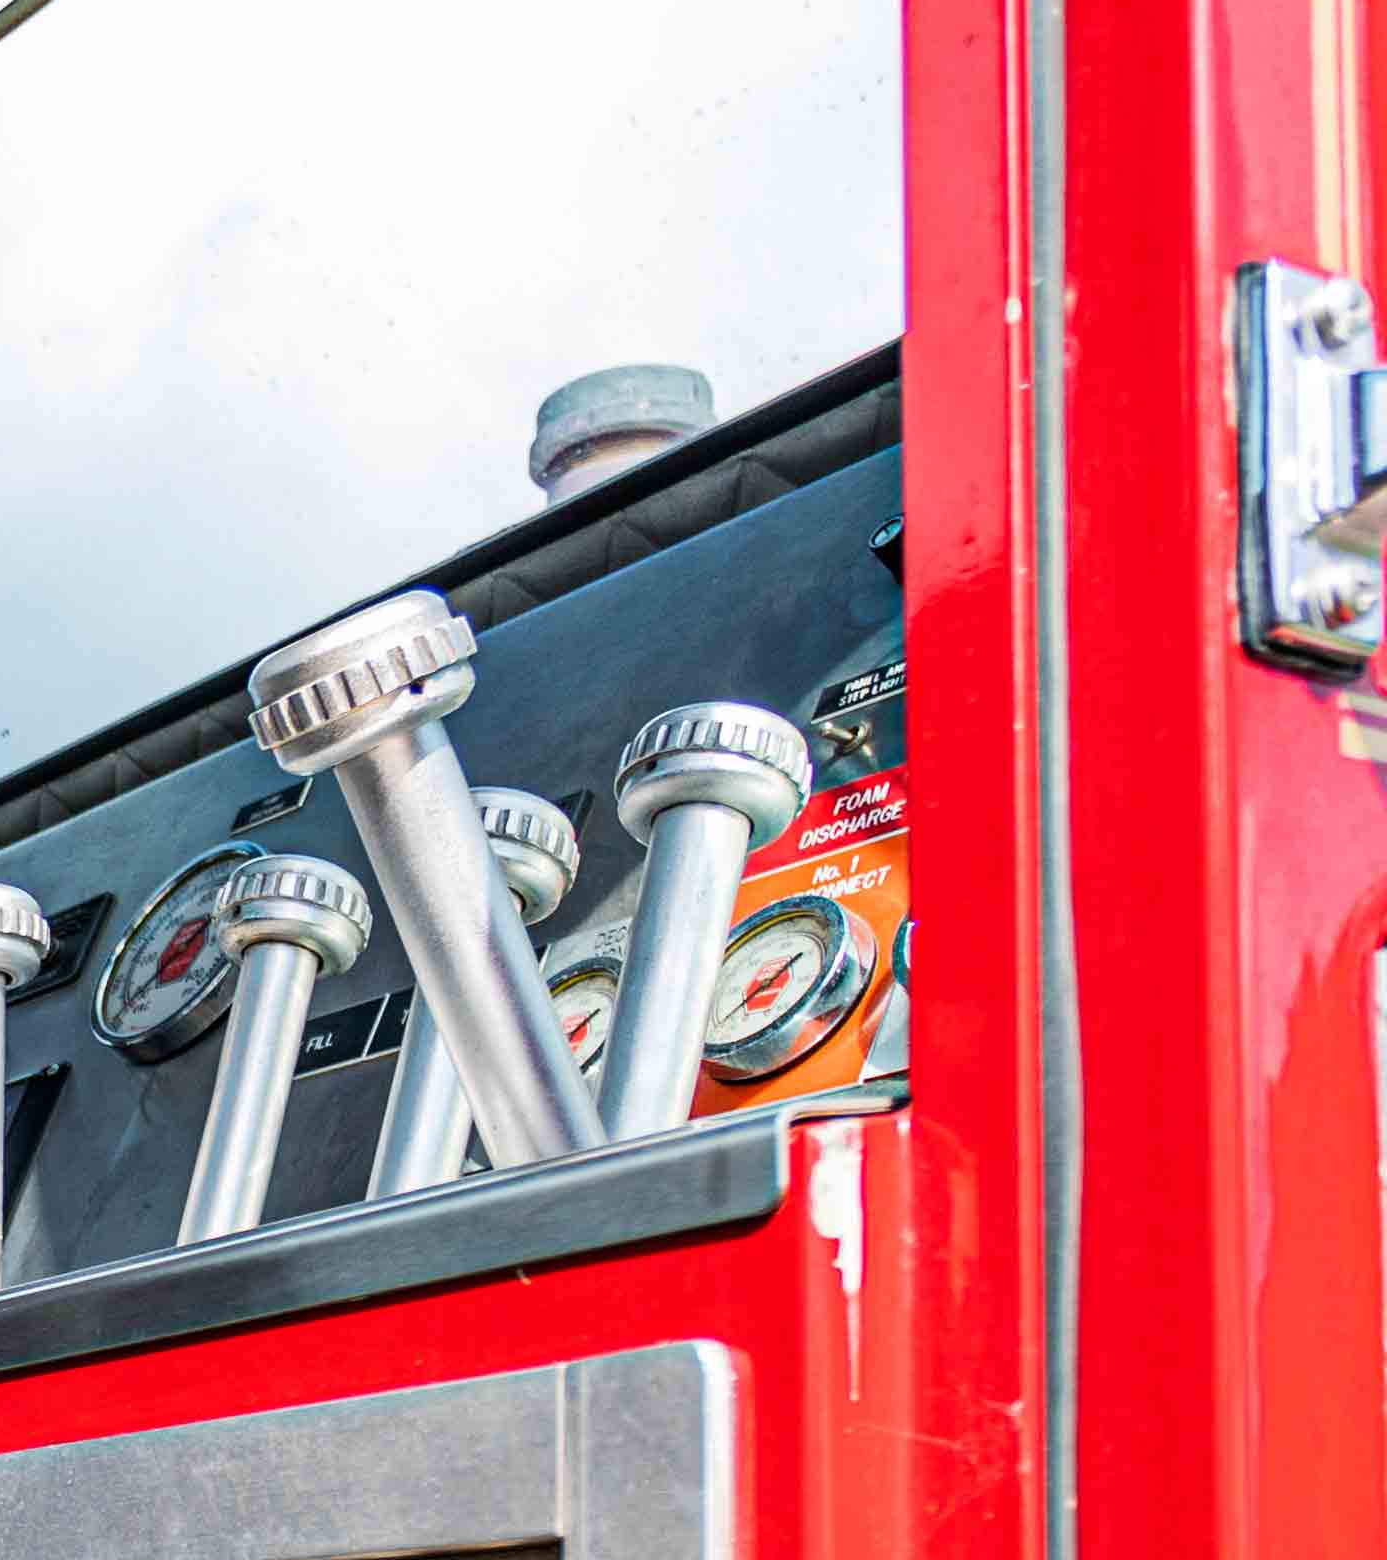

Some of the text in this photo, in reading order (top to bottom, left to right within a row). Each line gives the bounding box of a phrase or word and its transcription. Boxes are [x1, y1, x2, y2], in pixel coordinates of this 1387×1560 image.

[885, 662, 907, 679] AN
[838, 687, 870, 708] STEP
[833, 781, 891, 816] FOAM
[798, 799, 907, 850] DISCHARGE
[850, 855, 860, 873] 1
[305, 1032, 333, 1053] FILL
